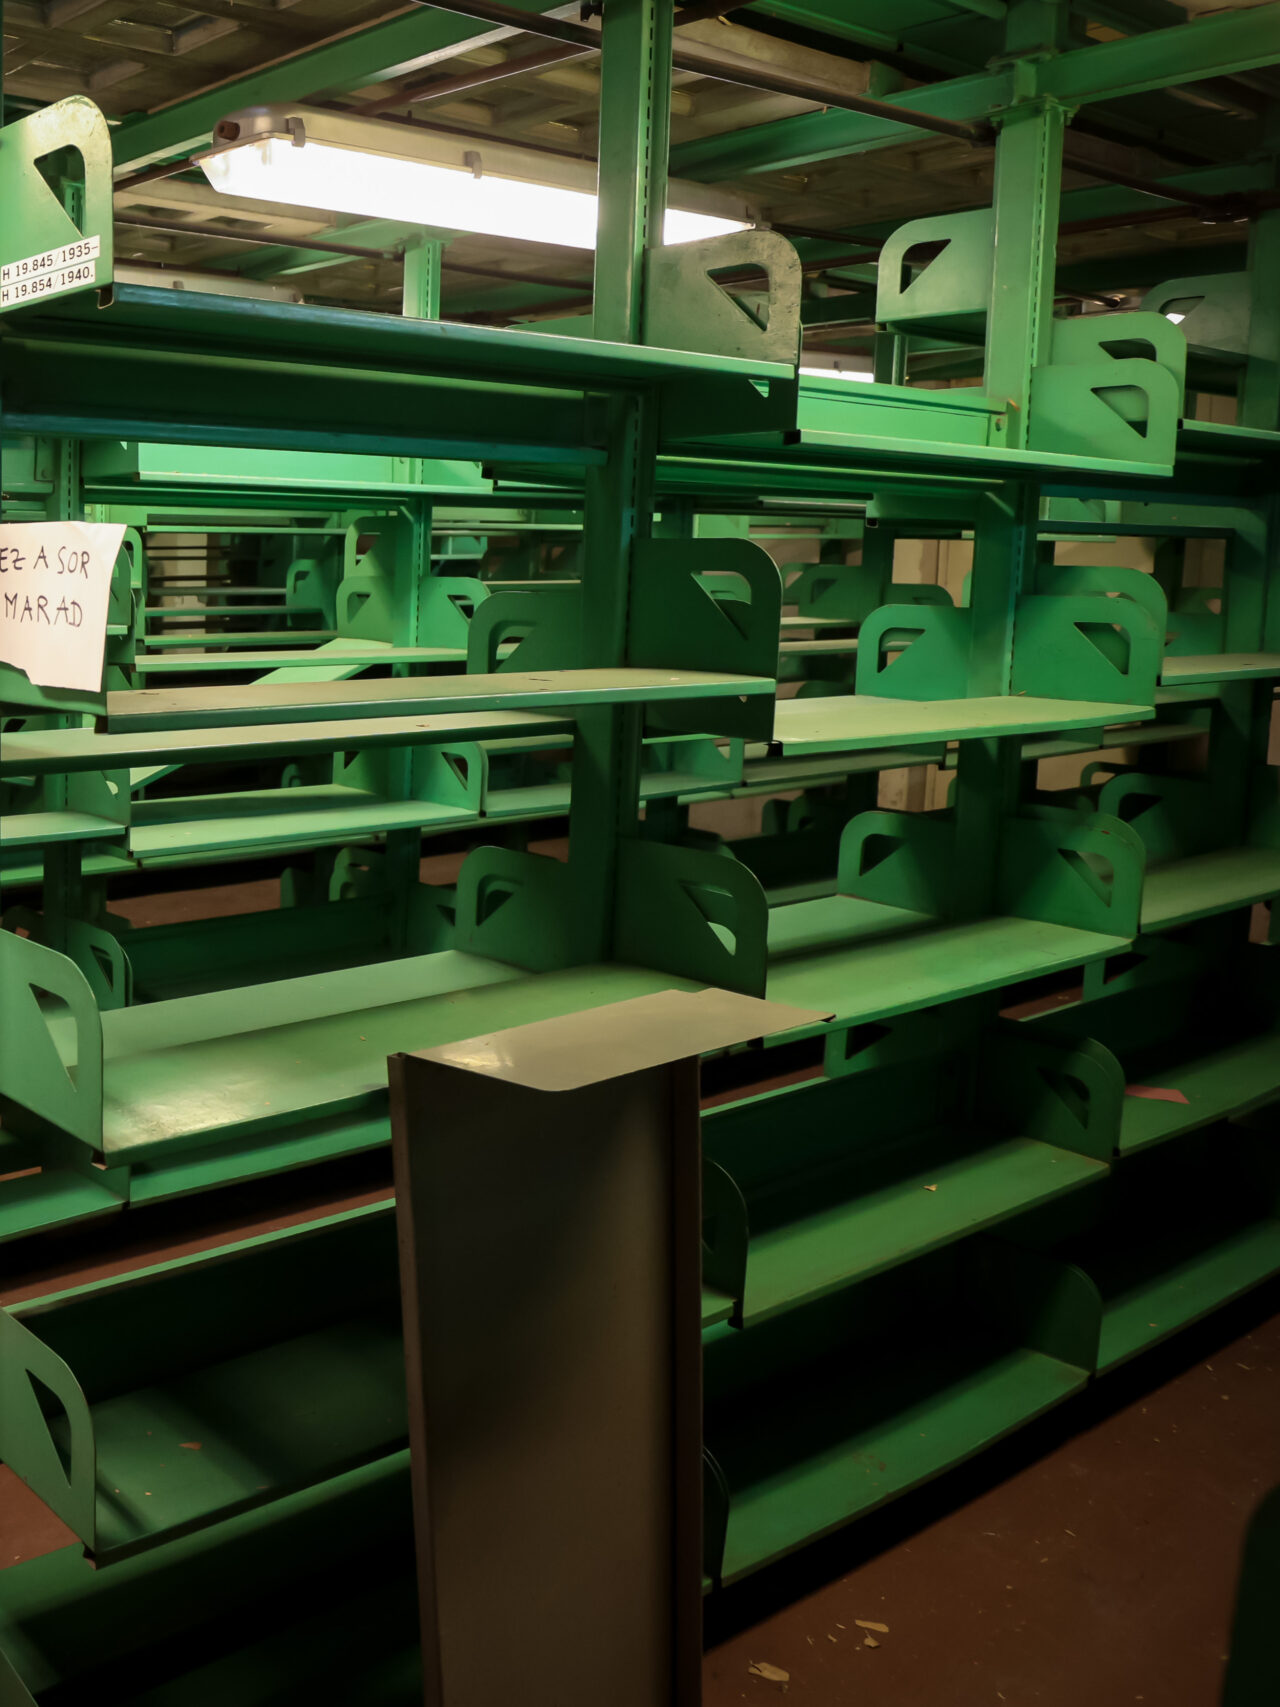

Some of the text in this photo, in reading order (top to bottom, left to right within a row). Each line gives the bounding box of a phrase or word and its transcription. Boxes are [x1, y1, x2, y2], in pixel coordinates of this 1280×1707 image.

[2, 267, 10, 281] H
[1, 289, 9, 302] H
[0, 545, 90, 579] EZ A SOR
[4, 592, 83, 628] MARAD
